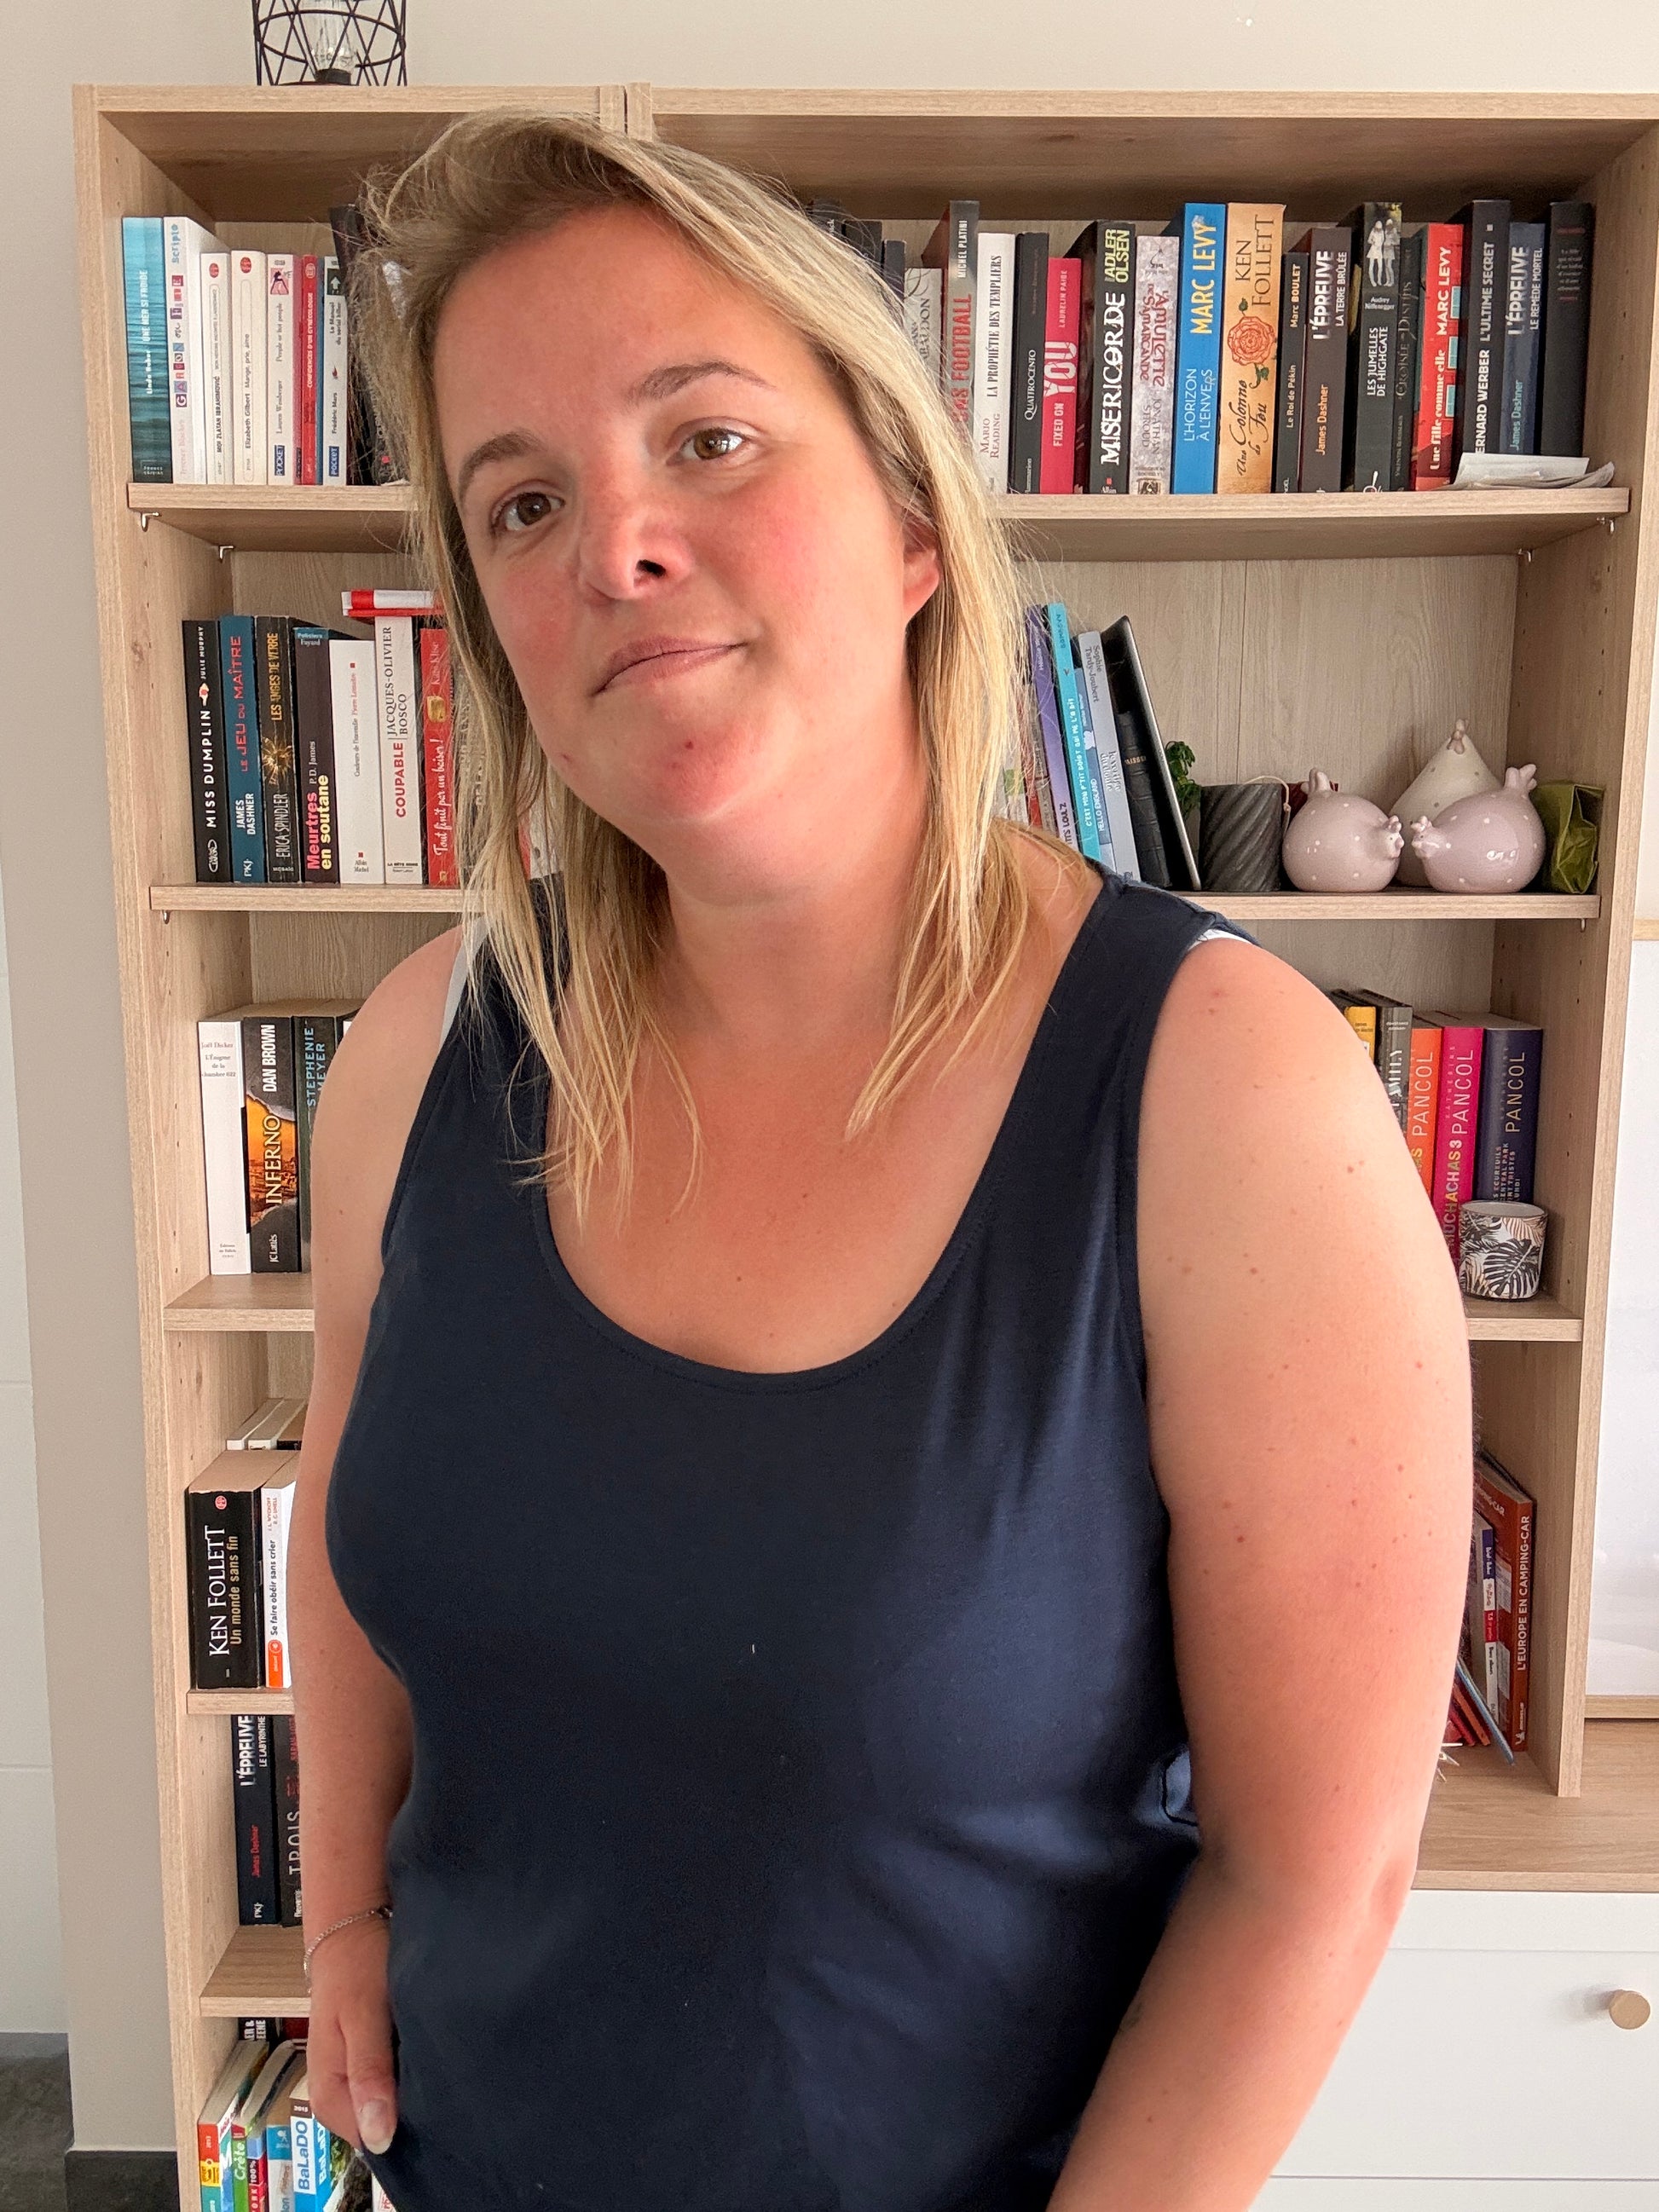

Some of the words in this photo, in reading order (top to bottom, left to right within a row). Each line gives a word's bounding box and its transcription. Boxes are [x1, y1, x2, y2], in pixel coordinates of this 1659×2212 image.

[958, 220, 968, 248] PLATINI
[1191, 223, 1217, 271] LEVY
[957, 251, 968, 277] MICHEL
[1103, 228, 1116, 277] ADLER
[1115, 229, 1130, 283] OLSEN
[1235, 240, 1251, 281] KEN
[1251, 215, 1274, 307] FOLLETT
[1335, 252, 1347, 285] BRÛLÉE
[1439, 246, 1451, 286] LEVY
[1481, 242, 1494, 285] SECRET
[1532, 248, 1543, 281] MORTEL
[139, 270, 148, 297] FROIDE
[989, 256, 1002, 308] TEMPLIERS
[1060, 269, 1068, 291] PAIGE
[1292, 263, 1301, 303] BOULET
[1310, 251, 1334, 339] L'ÉPREUVE
[1506, 246, 1529, 335] L'ÉPREUVE
[140, 309, 149, 325] MER
[1190, 279, 1216, 334] MARC
[1290, 305, 1299, 327] Marc
[1336, 287, 1345, 314] TERRE
[1436, 290, 1449, 336] MARC
[1479, 287, 1493, 341] L'ULTIME
[142, 326, 151, 341] UNE
[988, 311, 1000, 327] DES
[1335, 315, 1344, 326] LA
[1529, 319, 1540, 330] LE
[951, 293, 972, 380] FOOTBALL
[1367, 327, 1379, 378] JUMELLES
[1377, 326, 1388, 380] HIGHGATE
[986, 332, 1000, 382] PROPHÉTIE
[1043, 341, 1077, 397] YOU
[1435, 349, 1445, 373] elle
[986, 385, 997, 397] LA
[1024, 349, 1038, 420] QUATTROCENTO
[1101, 292, 1125, 465] MISERICORDE
[1286, 365, 1296, 388] Pékin
[1367, 379, 1377, 396] LES
[1377, 383, 1386, 396] DE
[1477, 349, 1490, 401] WERBER
[1054, 403, 1064, 416] ON
[1183, 369, 1197, 441] L'HORIZON
[1199, 369, 1216, 427] L'ENVERS
[1286, 403, 1295, 415] Roi
[1287, 390, 1295, 401] de
[1317, 384, 1329, 423] Dashner
[1435, 374, 1445, 418] comme
[1512, 380, 1523, 419] Dashner
[1142, 405, 1151, 448] STROUD
[1152, 399, 1161, 454] JONATHAN
[1228, 380, 1247, 446] Colonne
[1286, 417, 1295, 428] Le
[1475, 404, 1488, 453] ERNARD
[980, 419, 991, 453] MARIO
[990, 413, 1001, 459] READING
[1053, 419, 1063, 447] FIXED
[1199, 431, 1211, 441] À
[1315, 426, 1327, 455] James
[1430, 419, 1442, 444] fille
[1511, 421, 1521, 451] James
[275, 445, 285, 476] POCKET
[329, 446, 339, 476] POCKET
[1236, 450, 1247, 475] Une
[1430, 447, 1441, 469] Une
[267, 632, 279, 661] VERRE
[1094, 645, 1102, 673] Sophie
[229, 636, 244, 700] MAÎTRE
[269, 662, 280, 673] DE
[382, 627, 397, 736] JACQUES-OLIVIER
[1085, 648, 1100, 702] Tardy-Joubert
[238, 703, 246, 719] DU
[270, 705, 282, 720] LES
[398, 694, 408, 735] BOSCO
[200, 710, 214, 784] DUMPLIN
[235, 724, 246, 756] JEU
[308, 741, 318, 765] James
[240, 760, 247, 771] LE
[309, 768, 318, 784] P.D.
[393, 742, 406, 817] COUPABLE
[436, 775, 444, 788] un
[205, 791, 217, 828] MISS
[315, 775, 331, 843] soutane
[438, 790, 451, 806] par
[1081, 792, 1090, 807] MON
[1090, 779, 1101, 809] ENGLAND
[235, 800, 246, 829] JAMES
[245, 793, 256, 835] DASHNER
[274, 794, 290, 832] SPINDLER
[434, 809, 453, 830] finit
[1084, 809, 1092, 827] C'EST
[1095, 811, 1105, 831] HELLO
[276, 835, 291, 858] ERICA
[305, 792, 320, 869] Meurtres
[432, 832, 448, 855] Tout
[321, 849, 332, 869] en
[260, 1025, 276, 1066] BROWN
[262, 1069, 277, 1092] DAN
[304, 1027, 316, 1106] STEPHENIE
[315, 1043, 327, 1090] MEYER
[1413, 1052, 1433, 1136] PANCOL
[1451, 1050, 1473, 1134] PANCOL
[1506, 1052, 1525, 1132] PANCOL
[263, 1115, 282, 1204] INFERNO
[1449, 1140, 1462, 1149] 3
[226, 1536, 238, 1550] fin
[1519, 1516, 1530, 1596] CAMPING-CAR
[205, 1525, 228, 1608] FOLLETT
[228, 1555, 239, 1581] sans
[228, 1586, 241, 1624] monde
[1518, 1598, 1528, 1614] EN
[209, 1615, 230, 1656] KEN
[230, 1629, 241, 1644] Un
[270, 1626, 278, 1635] Se
[1517, 1616, 1528, 1670] L'EUROPE
[236, 1716, 256, 1786] L'ÉPREUVE
[258, 1716, 267, 1758] LABYRINTHE
[259, 1759, 267, 1767] LE
[296, 2121, 309, 2190] BaLaDO
